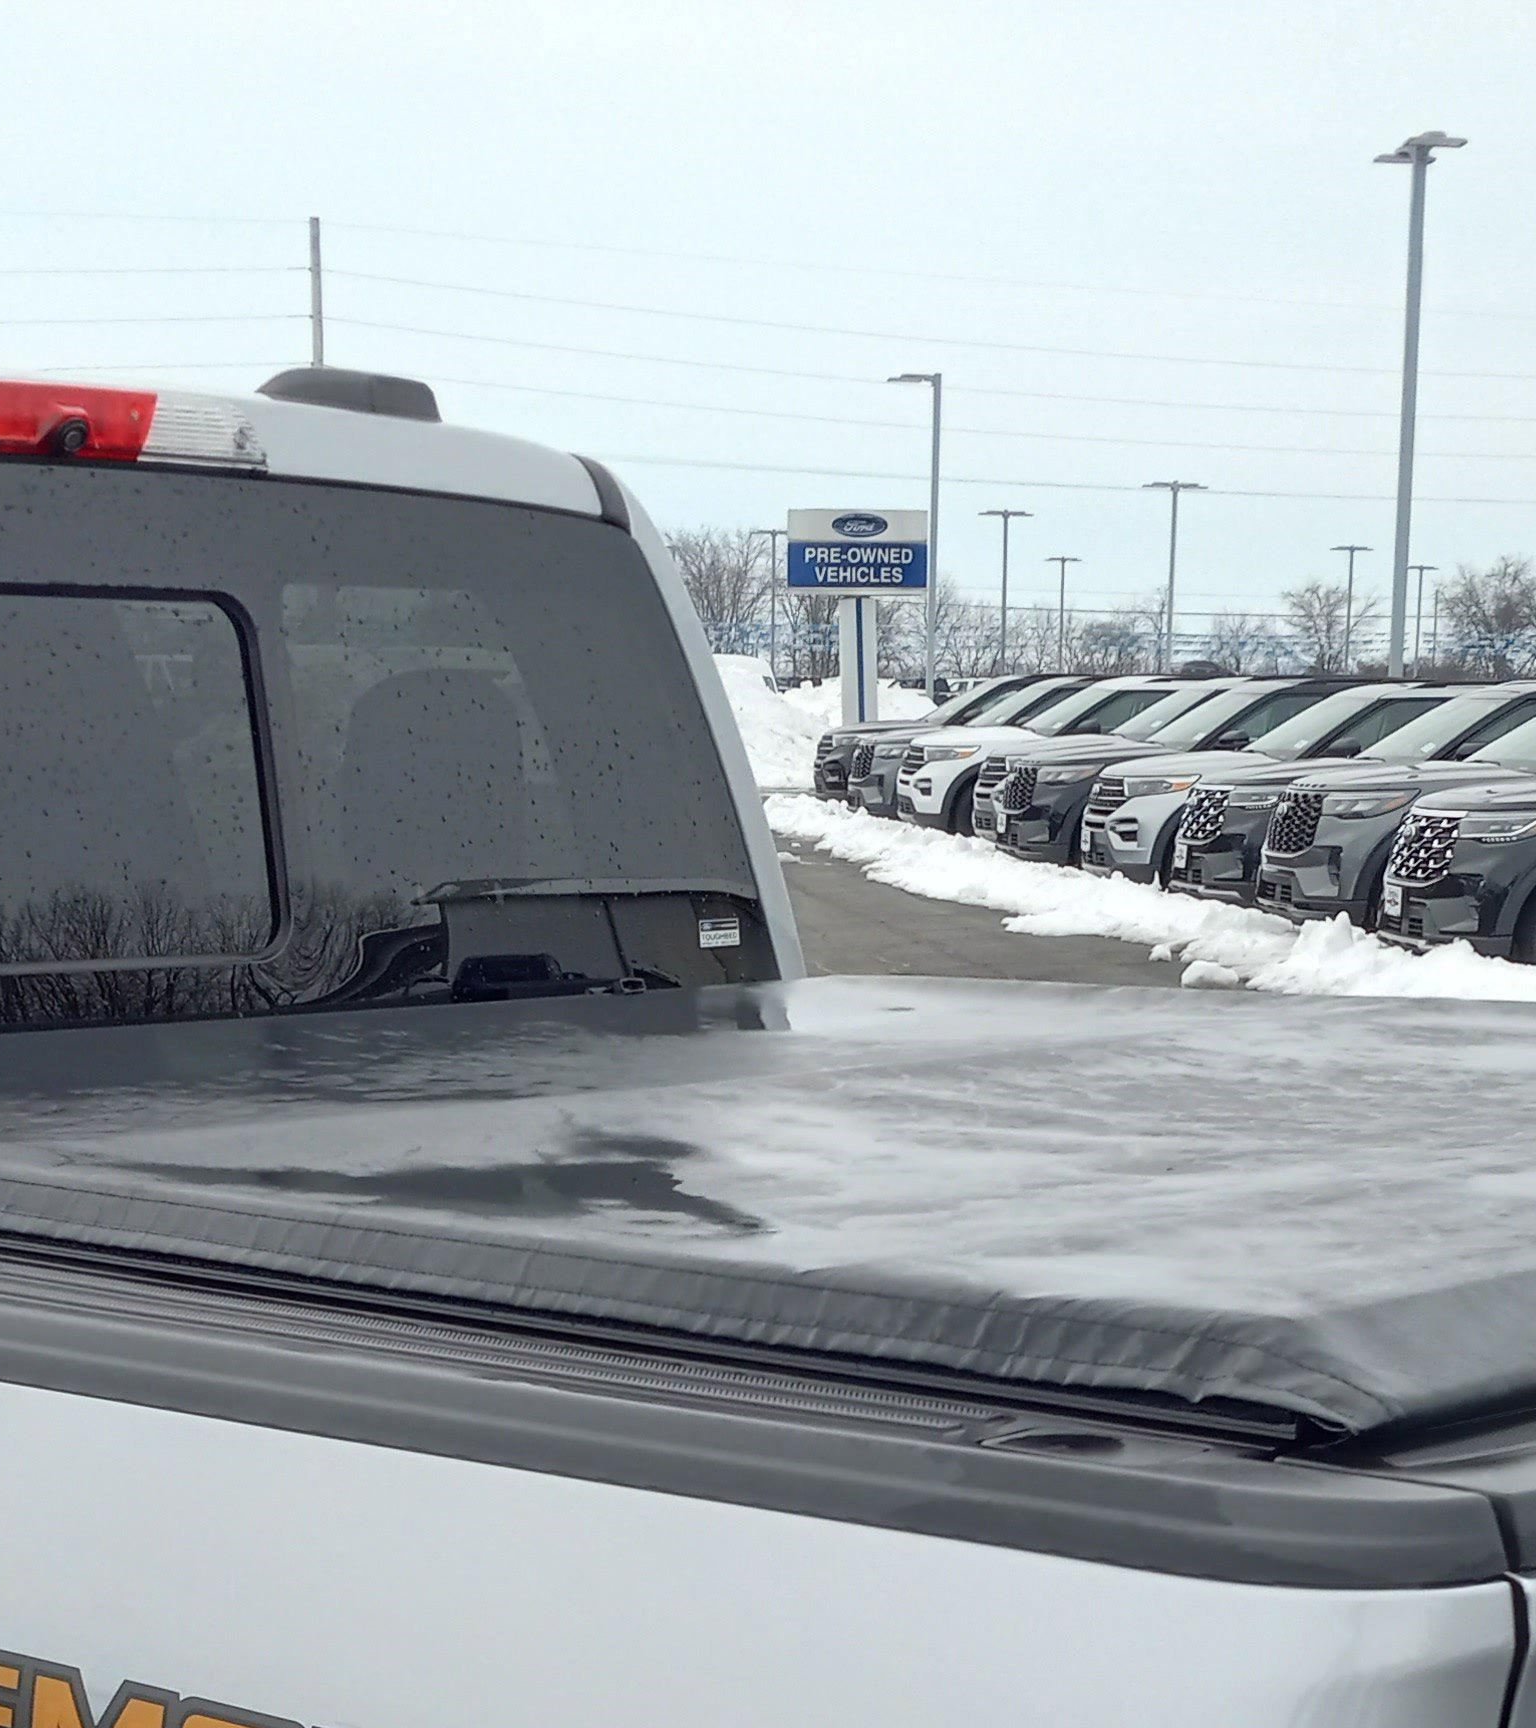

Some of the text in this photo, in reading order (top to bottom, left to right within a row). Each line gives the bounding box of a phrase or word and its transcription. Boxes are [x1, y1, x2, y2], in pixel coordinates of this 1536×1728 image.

[843, 519, 876, 532] Ford
[805, 547, 913, 564] PRE-OWNED
[814, 566, 903, 583] VEHICLES
